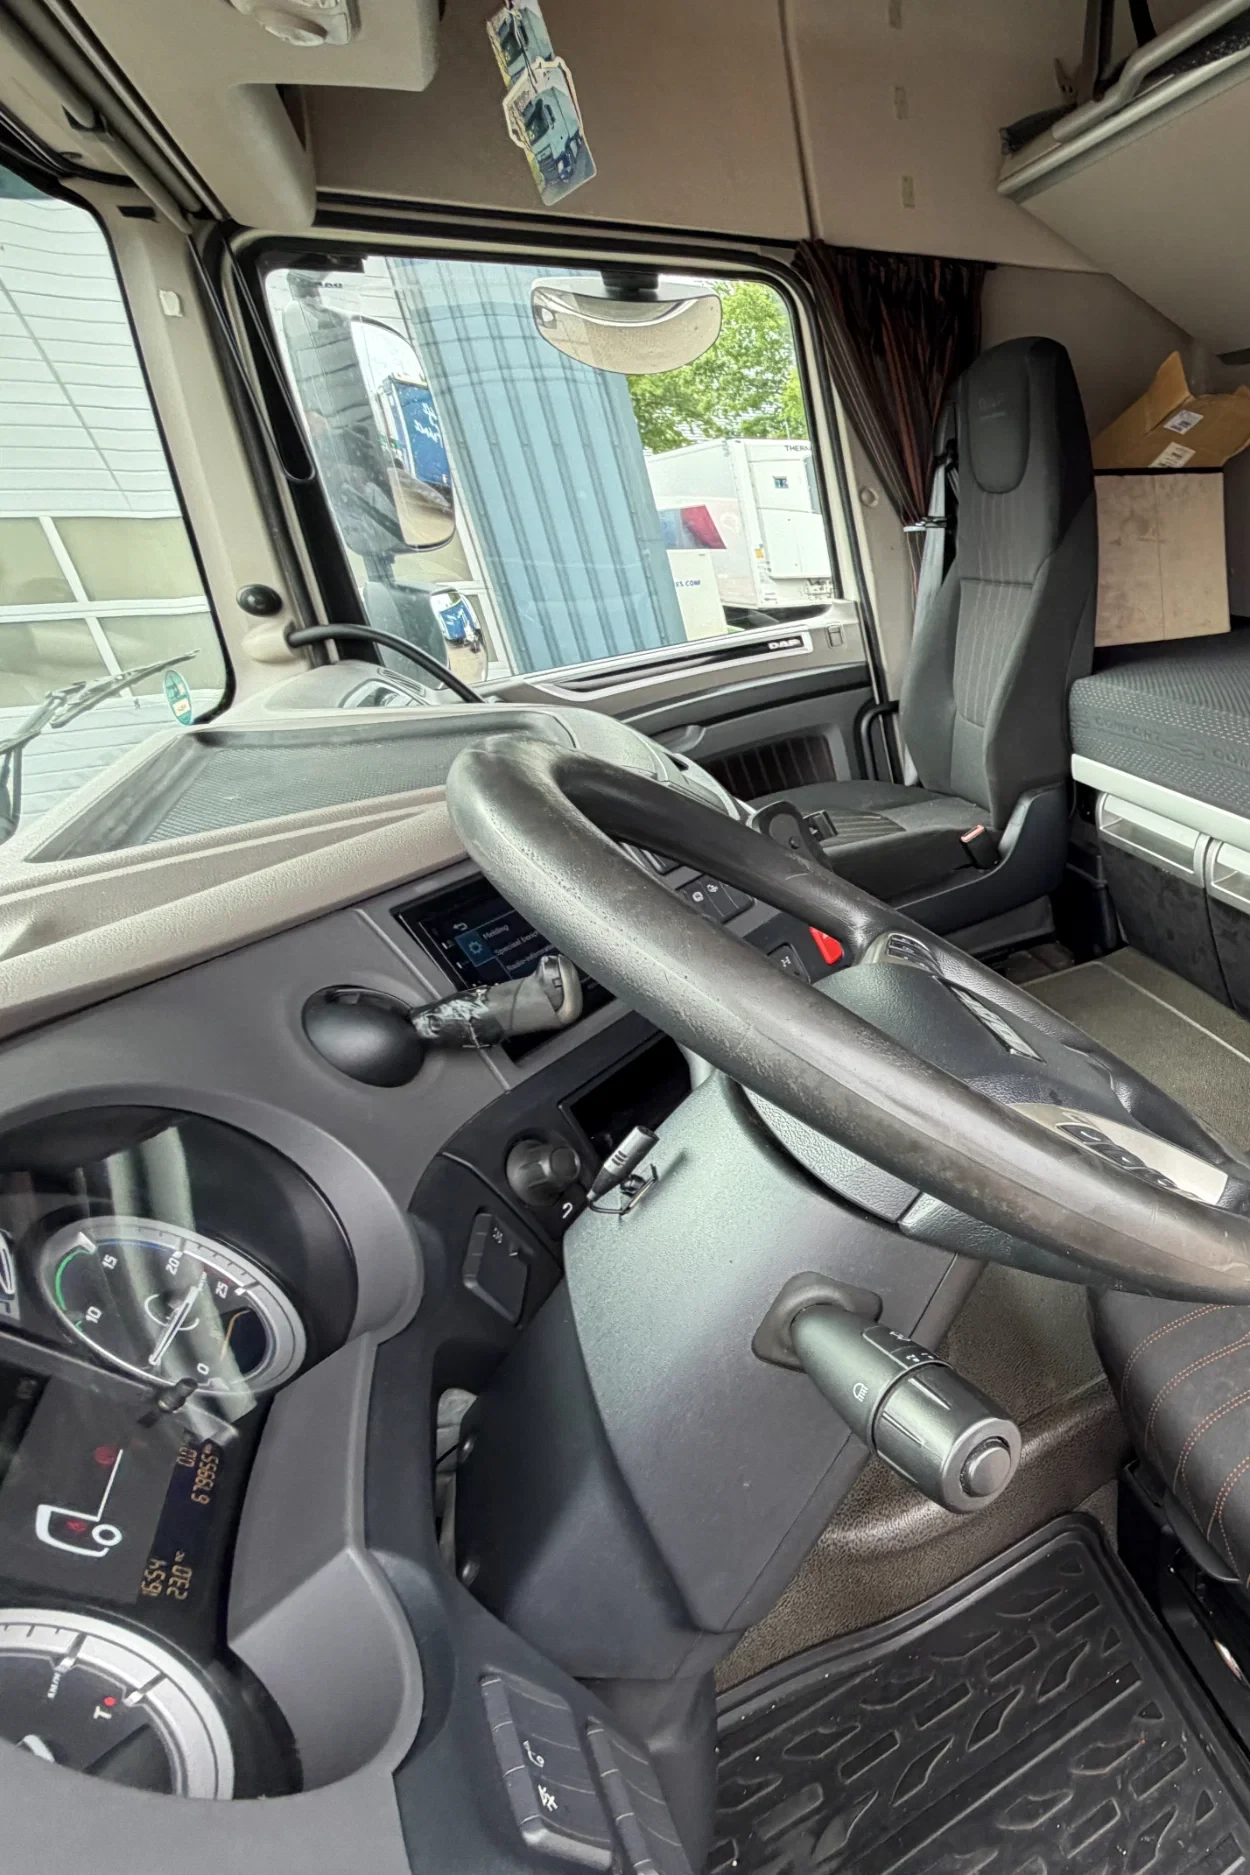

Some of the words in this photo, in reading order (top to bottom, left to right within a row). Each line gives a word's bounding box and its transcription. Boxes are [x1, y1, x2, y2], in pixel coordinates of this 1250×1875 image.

[768, 636, 801, 650] DAF
[102, 1253, 118, 1270] 15
[165, 1252, 181, 1275] 20
[215, 1281, 229, 1299] 25
[85, 1305, 103, 1324] 10
[196, 1363, 210, 1376] 0
[190, 1453, 220, 1505] 679955
